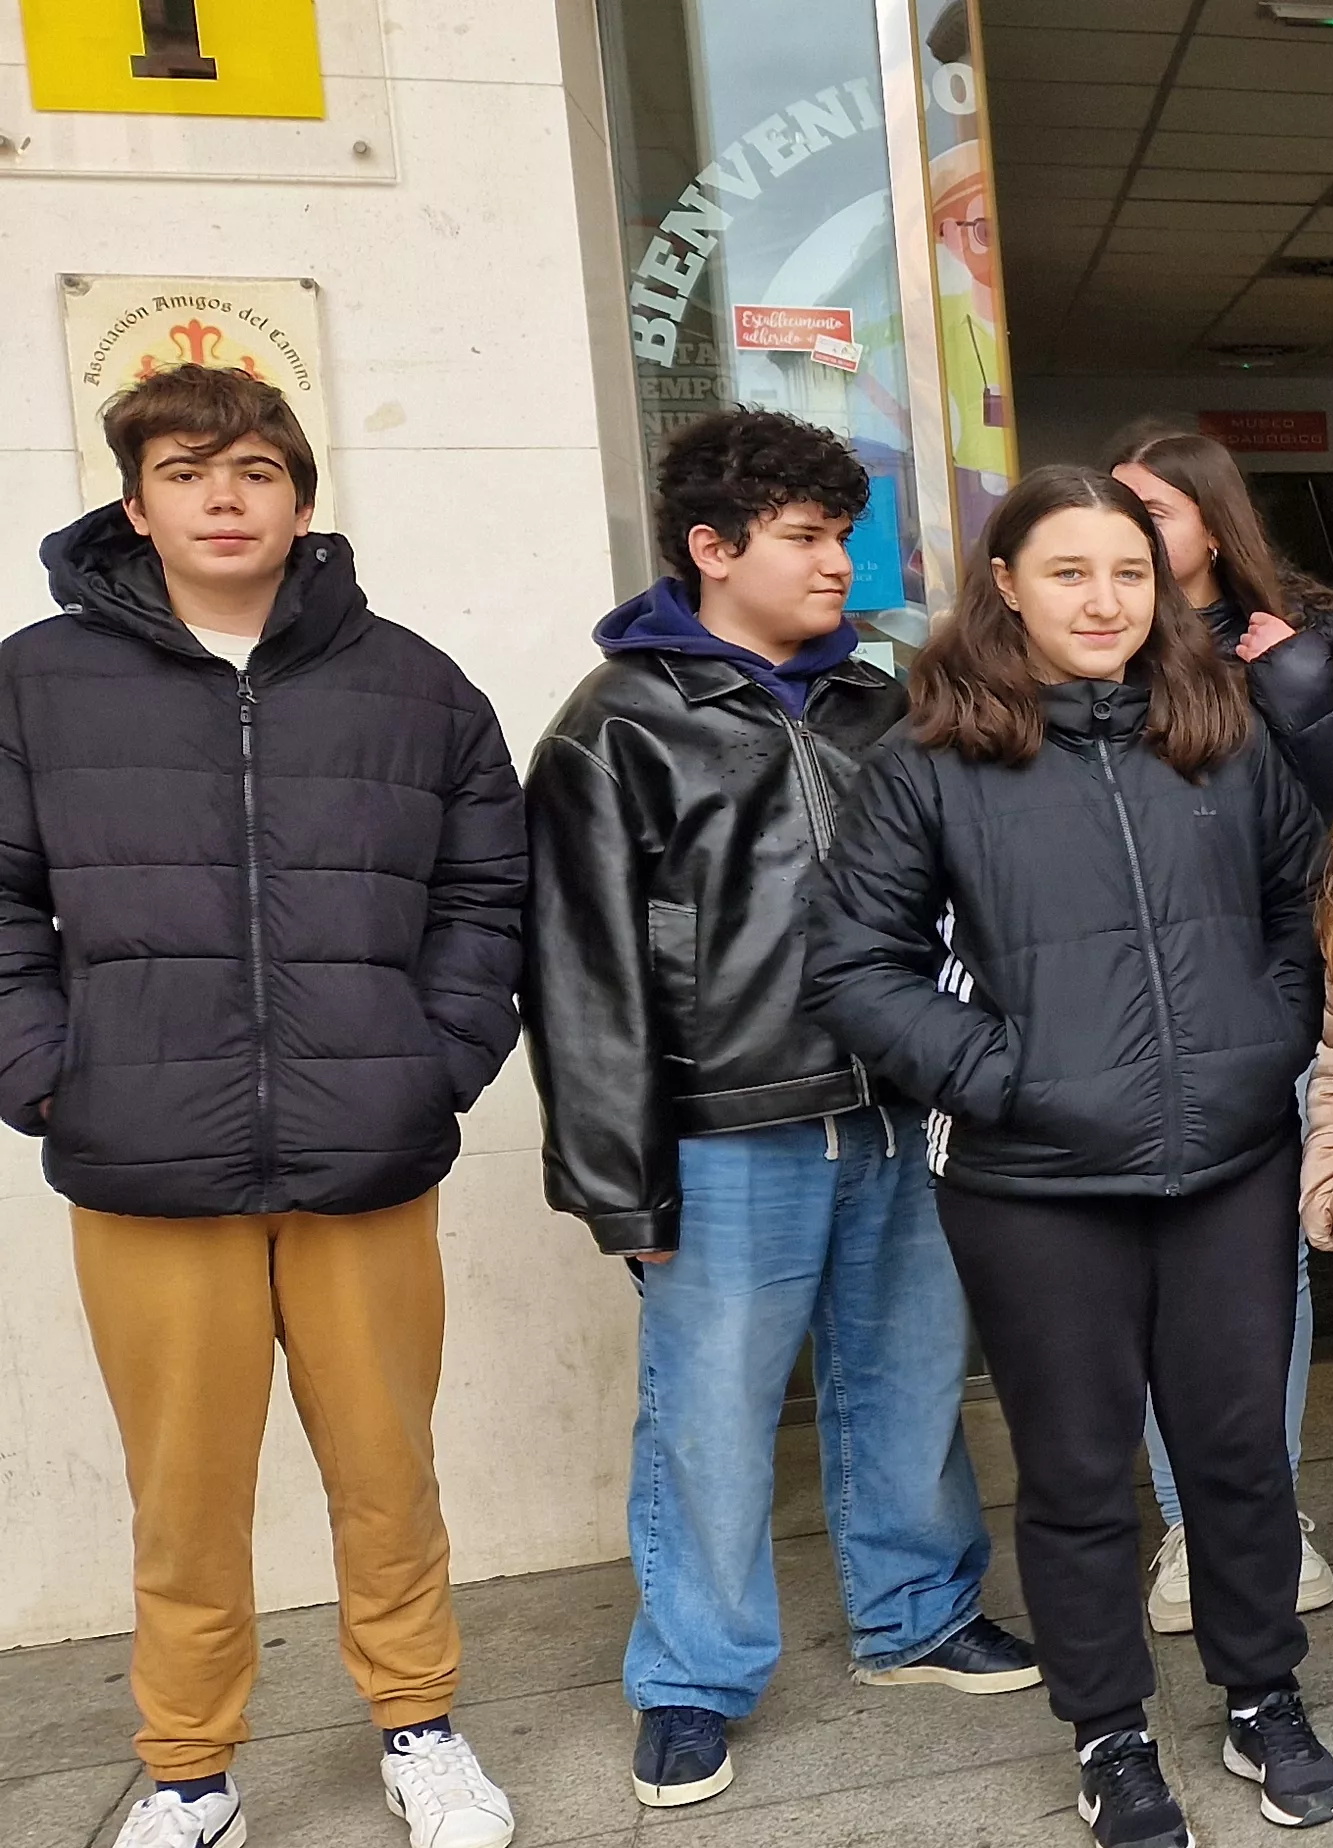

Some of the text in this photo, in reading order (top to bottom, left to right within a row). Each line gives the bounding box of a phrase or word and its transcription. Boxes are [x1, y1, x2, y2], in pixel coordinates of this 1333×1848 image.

[630, 62, 977, 368] BIENVENIO
[83, 295, 312, 392] Asociación Amigos del Camino
[742, 311, 844, 330] Establecimiento
[742, 327, 801, 345] adherido
